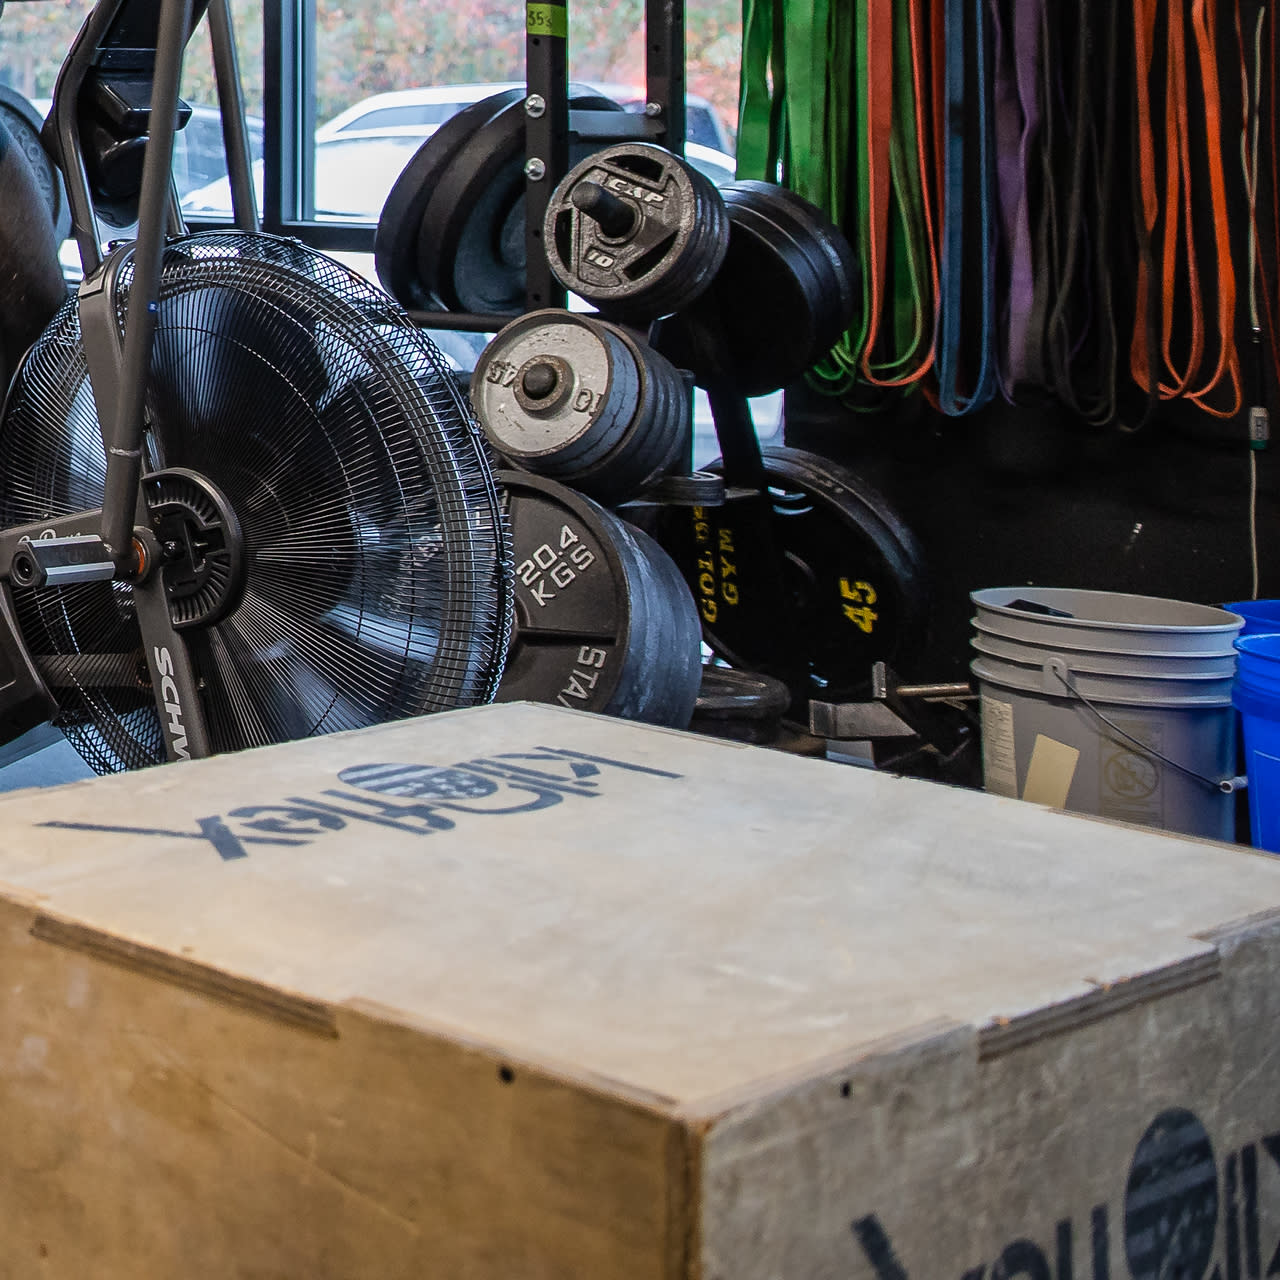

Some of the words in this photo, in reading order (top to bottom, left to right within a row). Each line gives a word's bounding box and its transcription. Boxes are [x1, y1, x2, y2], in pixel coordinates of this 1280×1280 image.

[608, 178, 664, 203] CAP
[586, 251, 614, 268] 10
[516, 523, 579, 587] 20.4
[530, 544, 596, 607] KGS
[839, 577, 879, 634] 45
[556, 644, 608, 709] STA
